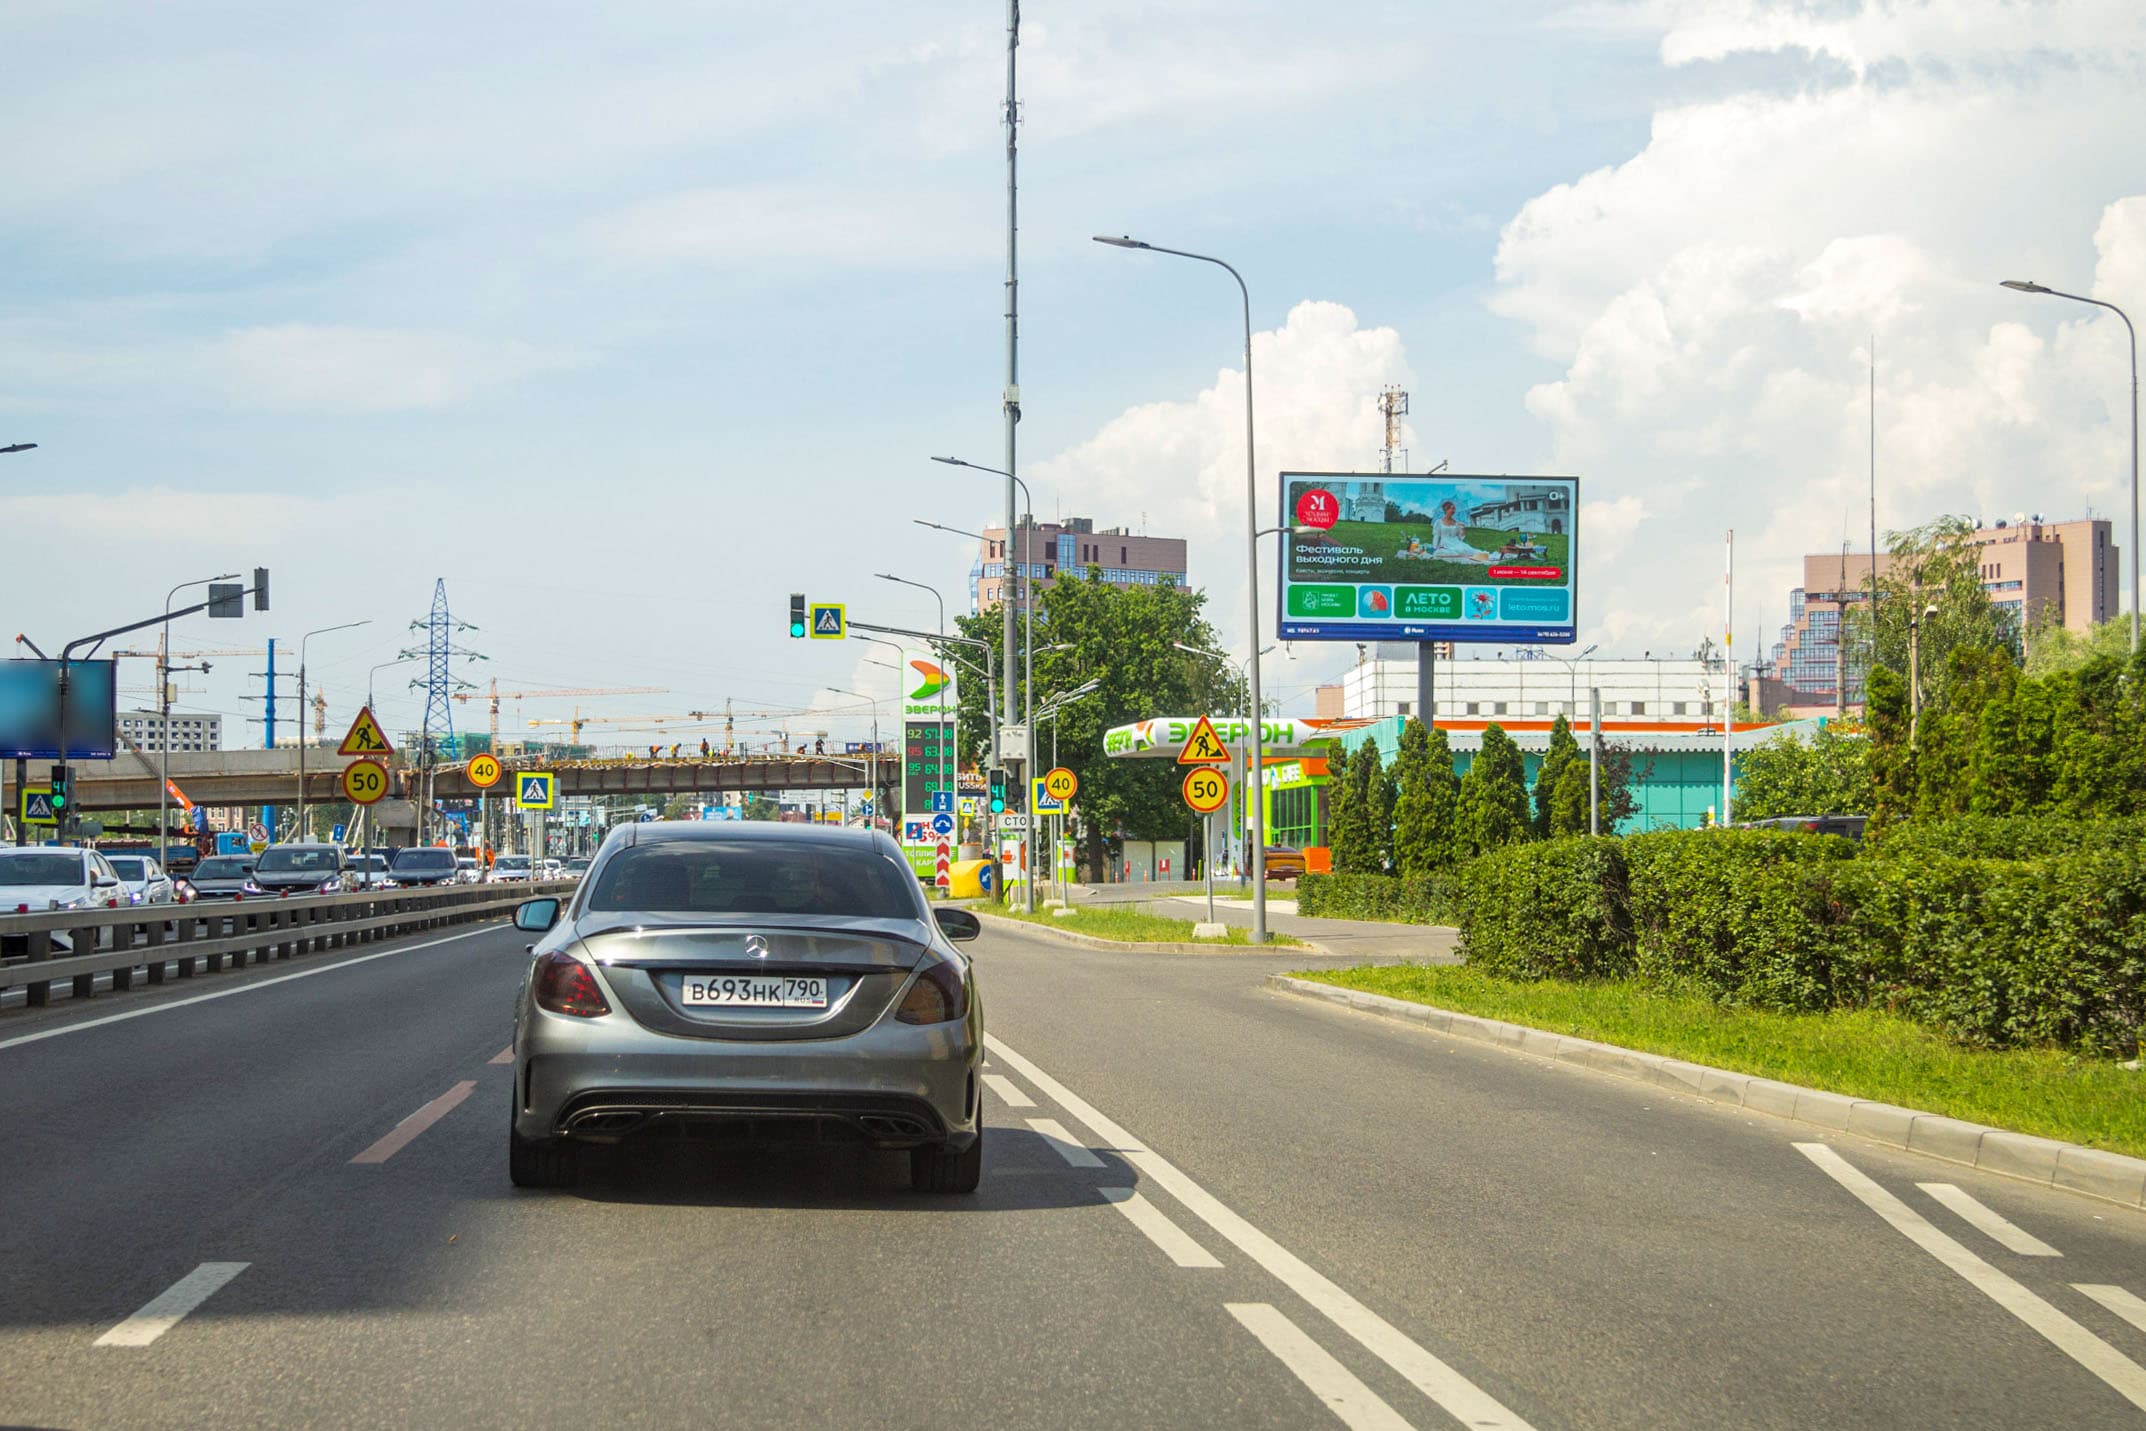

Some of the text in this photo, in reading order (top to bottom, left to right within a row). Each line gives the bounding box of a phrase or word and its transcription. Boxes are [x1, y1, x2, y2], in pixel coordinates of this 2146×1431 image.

[1296, 544, 1364, 555] Фестиваль
[1296, 555, 1383, 566] выходного дня
[1406, 592, 1452, 605] ЛЕТО
[1414, 606, 1452, 614] МОСКВЕ
[1508, 603, 1560, 612] leto.mos.ru
[907, 729, 922, 739] 92
[1168, 722, 1294, 744] ЭЕРОН
[475, 764, 494, 777] 40
[53, 781, 66, 793] 41
[353, 773, 379, 791] 50
[1052, 777, 1070, 791] 40
[1194, 781, 1218, 798] 50
[1004, 816, 1031, 826] СТО
[692, 979, 820, 1002] В693НК 790
